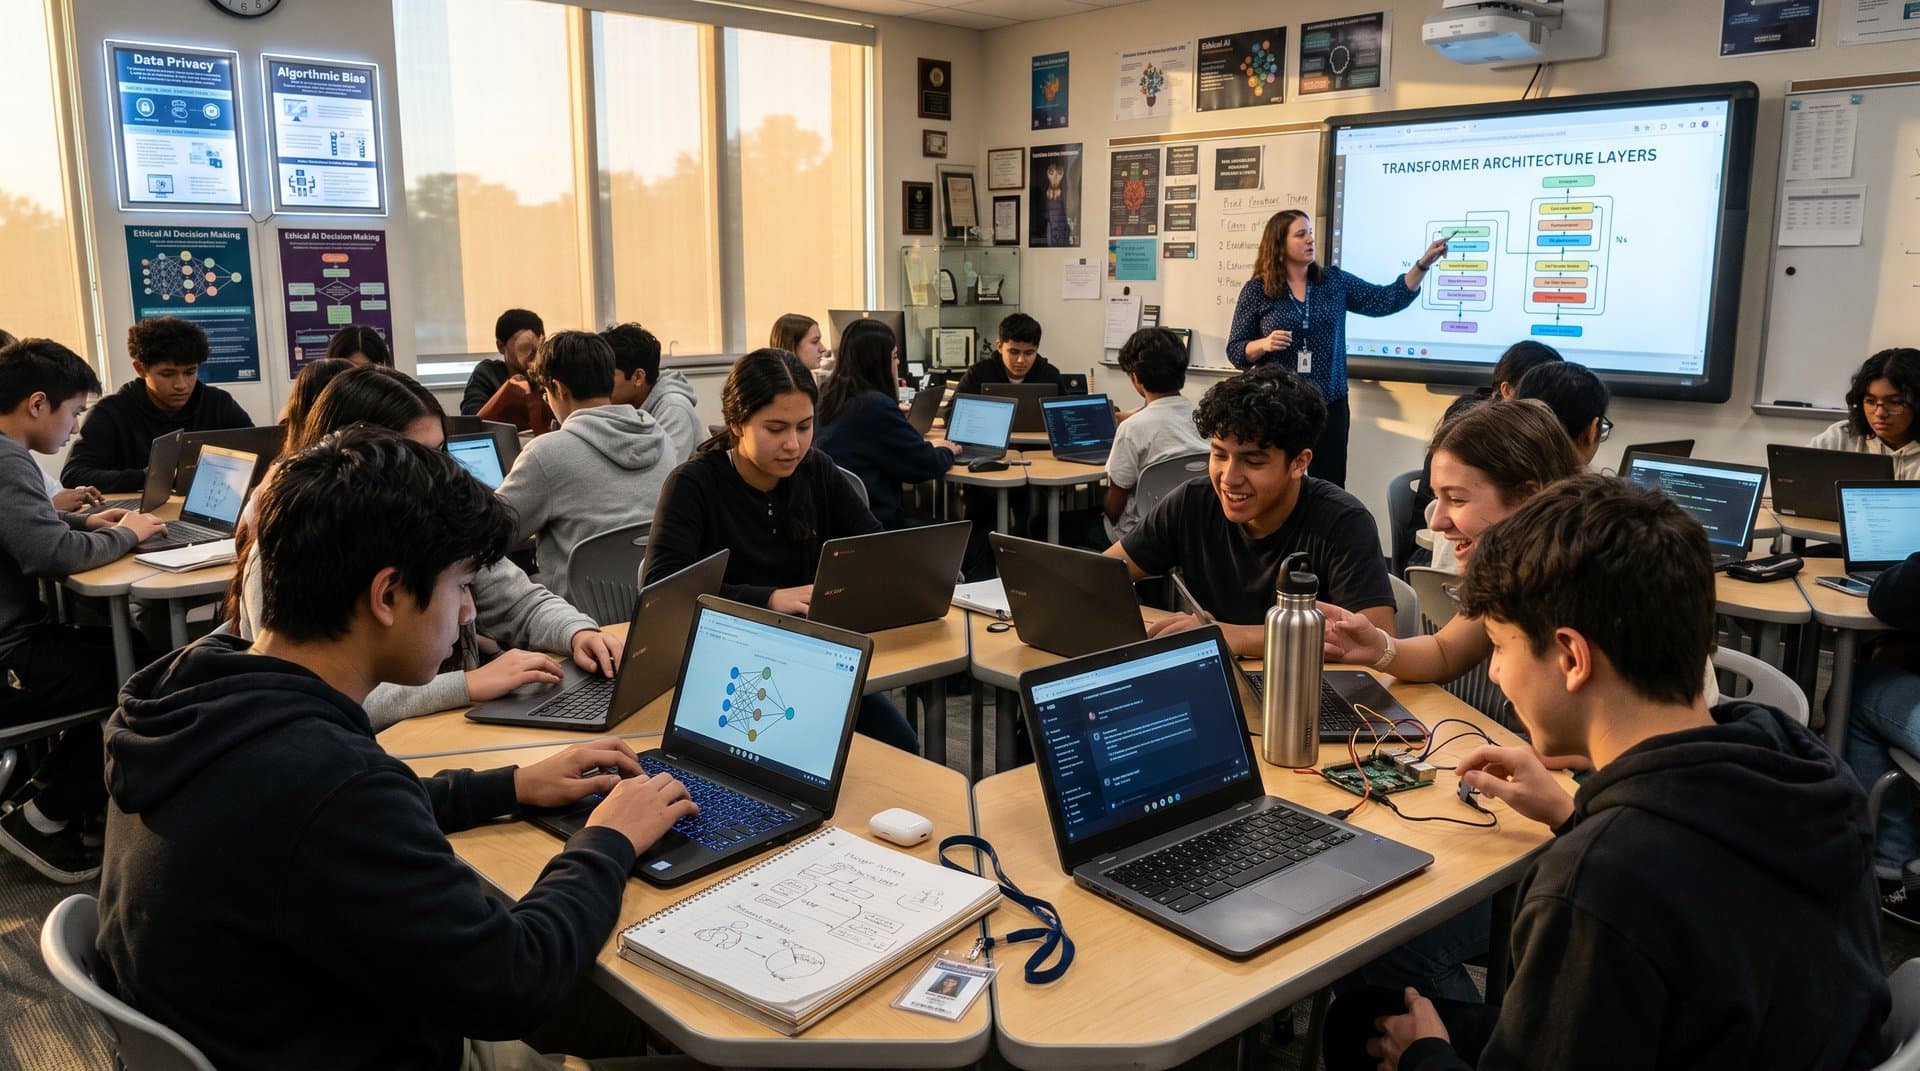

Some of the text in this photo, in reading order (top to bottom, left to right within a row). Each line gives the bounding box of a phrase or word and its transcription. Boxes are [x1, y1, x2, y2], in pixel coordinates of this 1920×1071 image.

[133, 54, 214, 73] Data Privacy
[342, 72, 366, 84] Bias
[1382, 148, 1657, 175] TRANSFORMER ARCHITECTURE LAYERS
[133, 229, 241, 240] Ethical AI Decision Making
[284, 232, 380, 242] Ethical AI Decision Making
